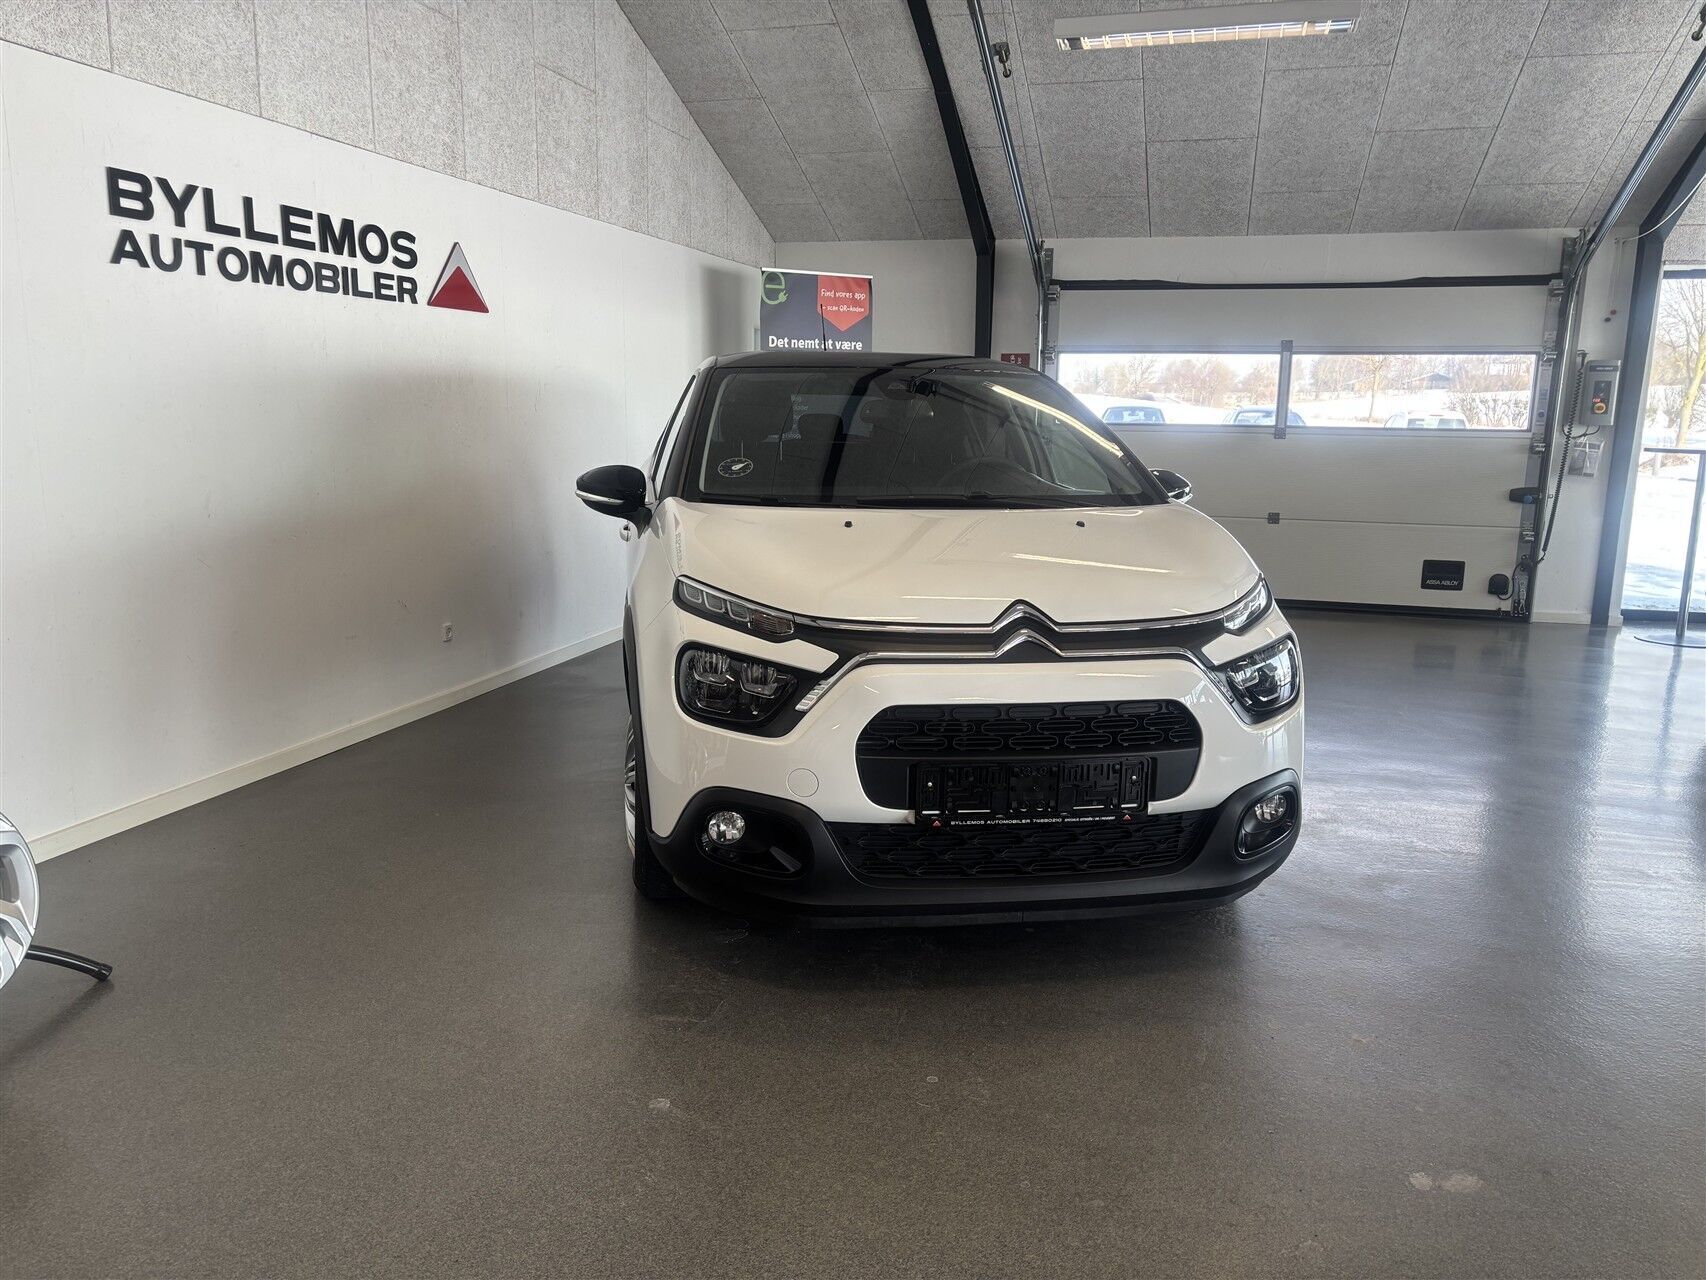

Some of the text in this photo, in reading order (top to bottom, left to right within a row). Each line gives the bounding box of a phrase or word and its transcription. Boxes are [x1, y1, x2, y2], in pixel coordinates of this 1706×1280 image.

[106, 165, 418, 270] BYLLEMOS
[109, 228, 418, 304] AUTOMOBILER
[820, 288, 866, 300] Find vores app
[768, 335, 863, 350] Det nemt at være
